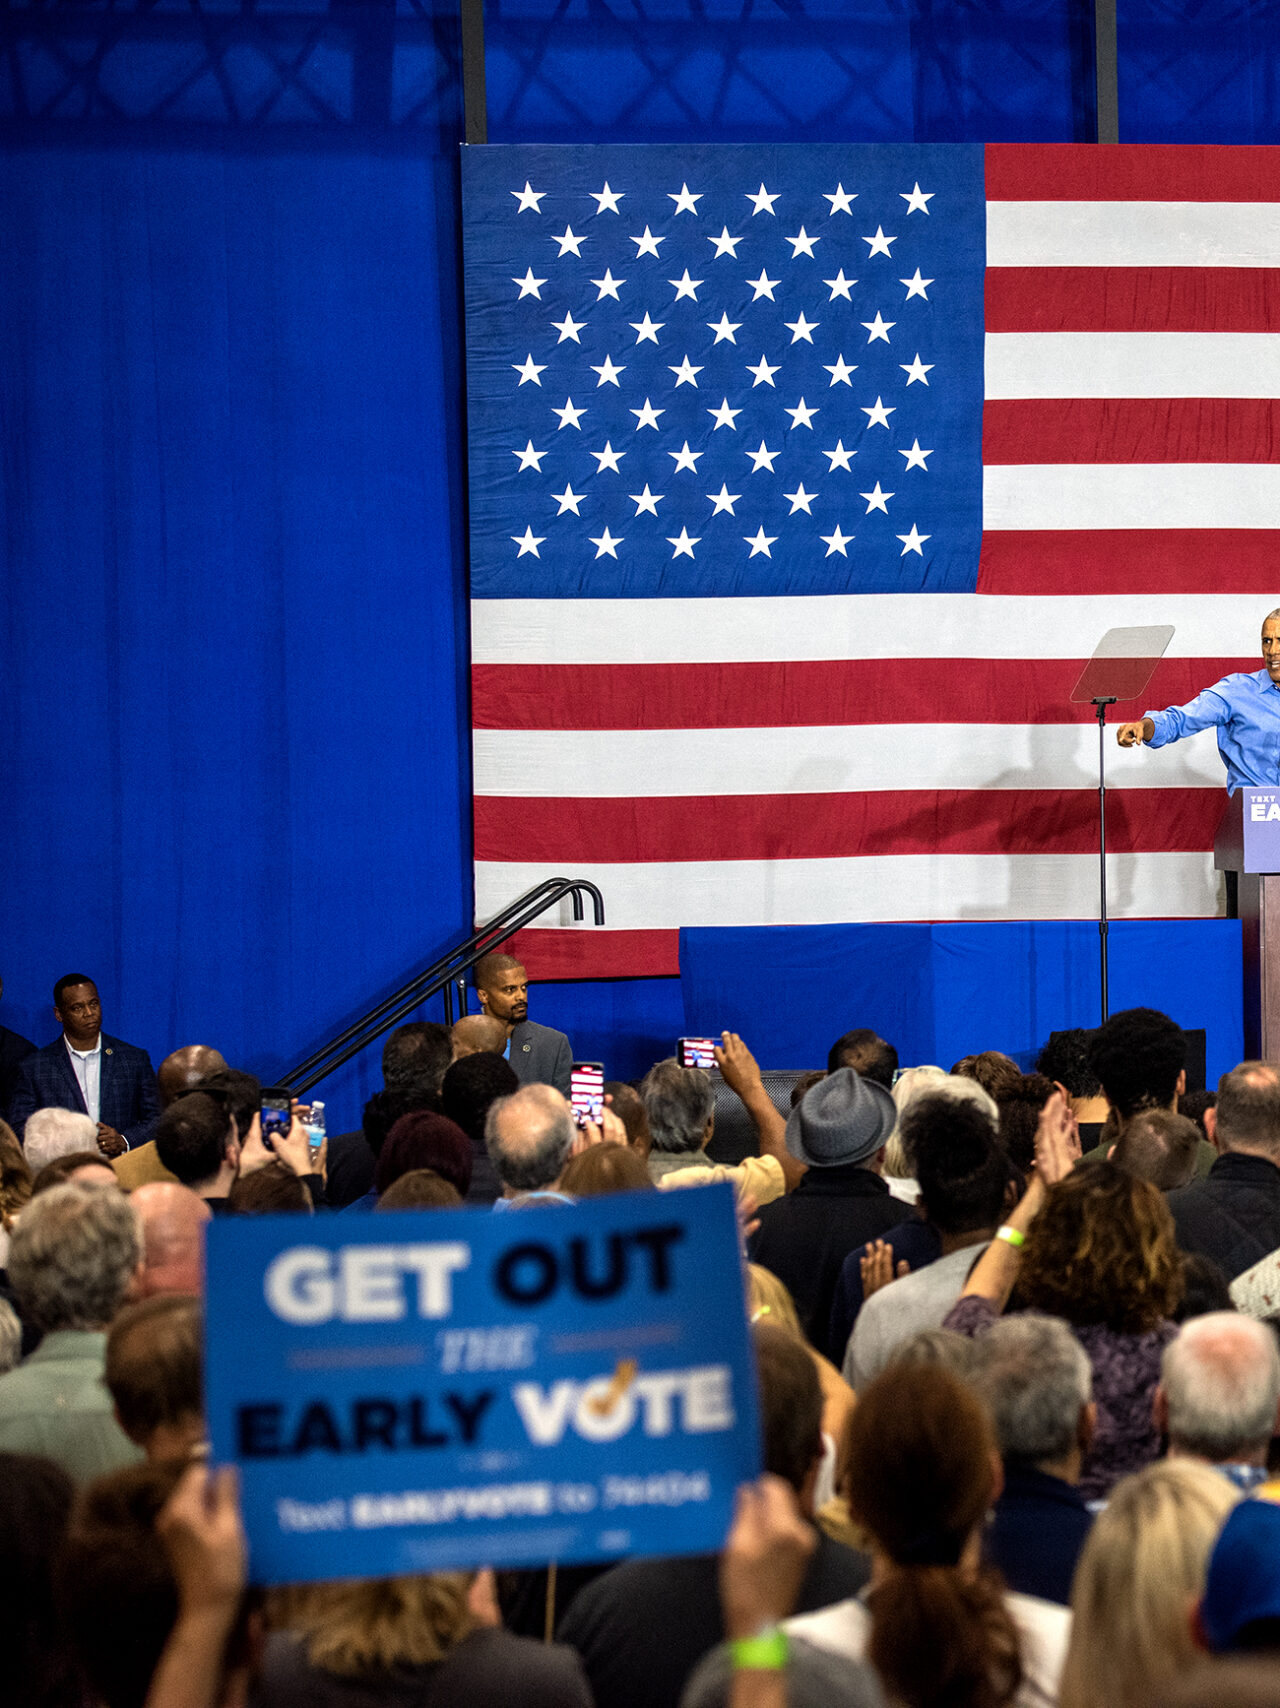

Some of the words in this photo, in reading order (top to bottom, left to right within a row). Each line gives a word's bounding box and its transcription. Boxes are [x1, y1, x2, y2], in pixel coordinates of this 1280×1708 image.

[265, 1241, 469, 1325] GET
[493, 1222, 685, 1307] OUT
[437, 1323, 538, 1373] THE
[236, 1388, 493, 1459] EARLY
[514, 1361, 735, 1445] VOTE
